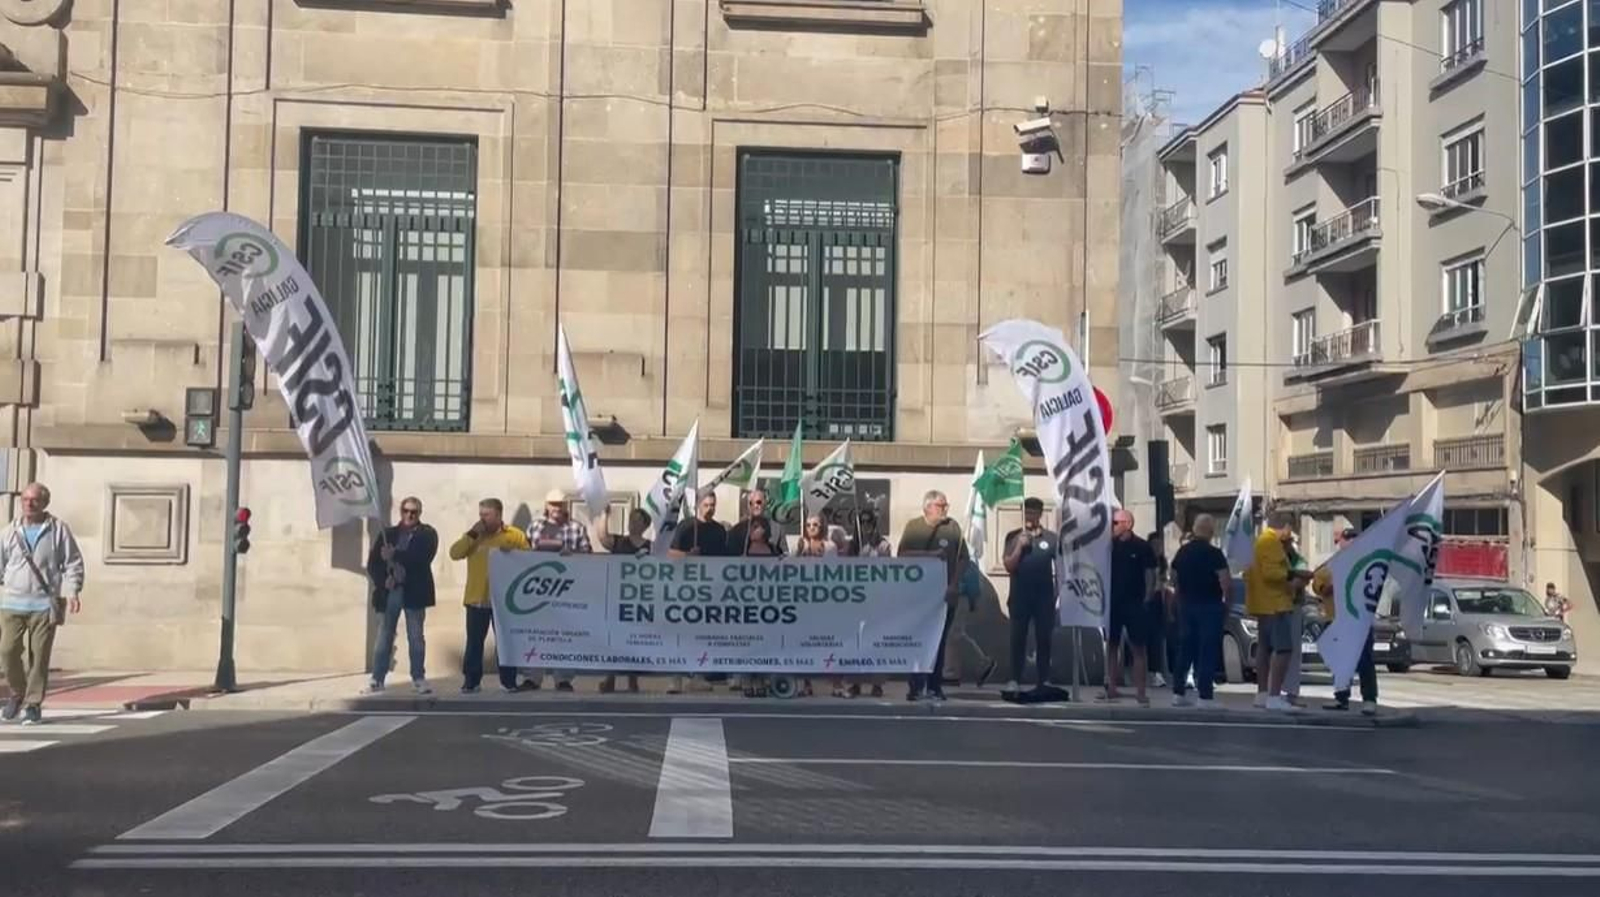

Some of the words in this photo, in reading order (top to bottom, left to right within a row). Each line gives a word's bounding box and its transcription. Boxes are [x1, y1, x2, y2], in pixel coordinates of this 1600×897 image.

[620, 562, 675, 581] POR
[683, 564, 713, 581] EL
[722, 564, 924, 582] CUMPLIMIENTO
[522, 576, 574, 597] CSIF
[619, 583, 654, 601] DE
[663, 584, 713, 602] LOS
[720, 585, 866, 603] ACUERDOS
[618, 603, 654, 622] EN
[664, 604, 798, 624] CORREOS
[540, 653, 600, 662] CONDICIONES
[601, 655, 655, 665] LABORALES,
